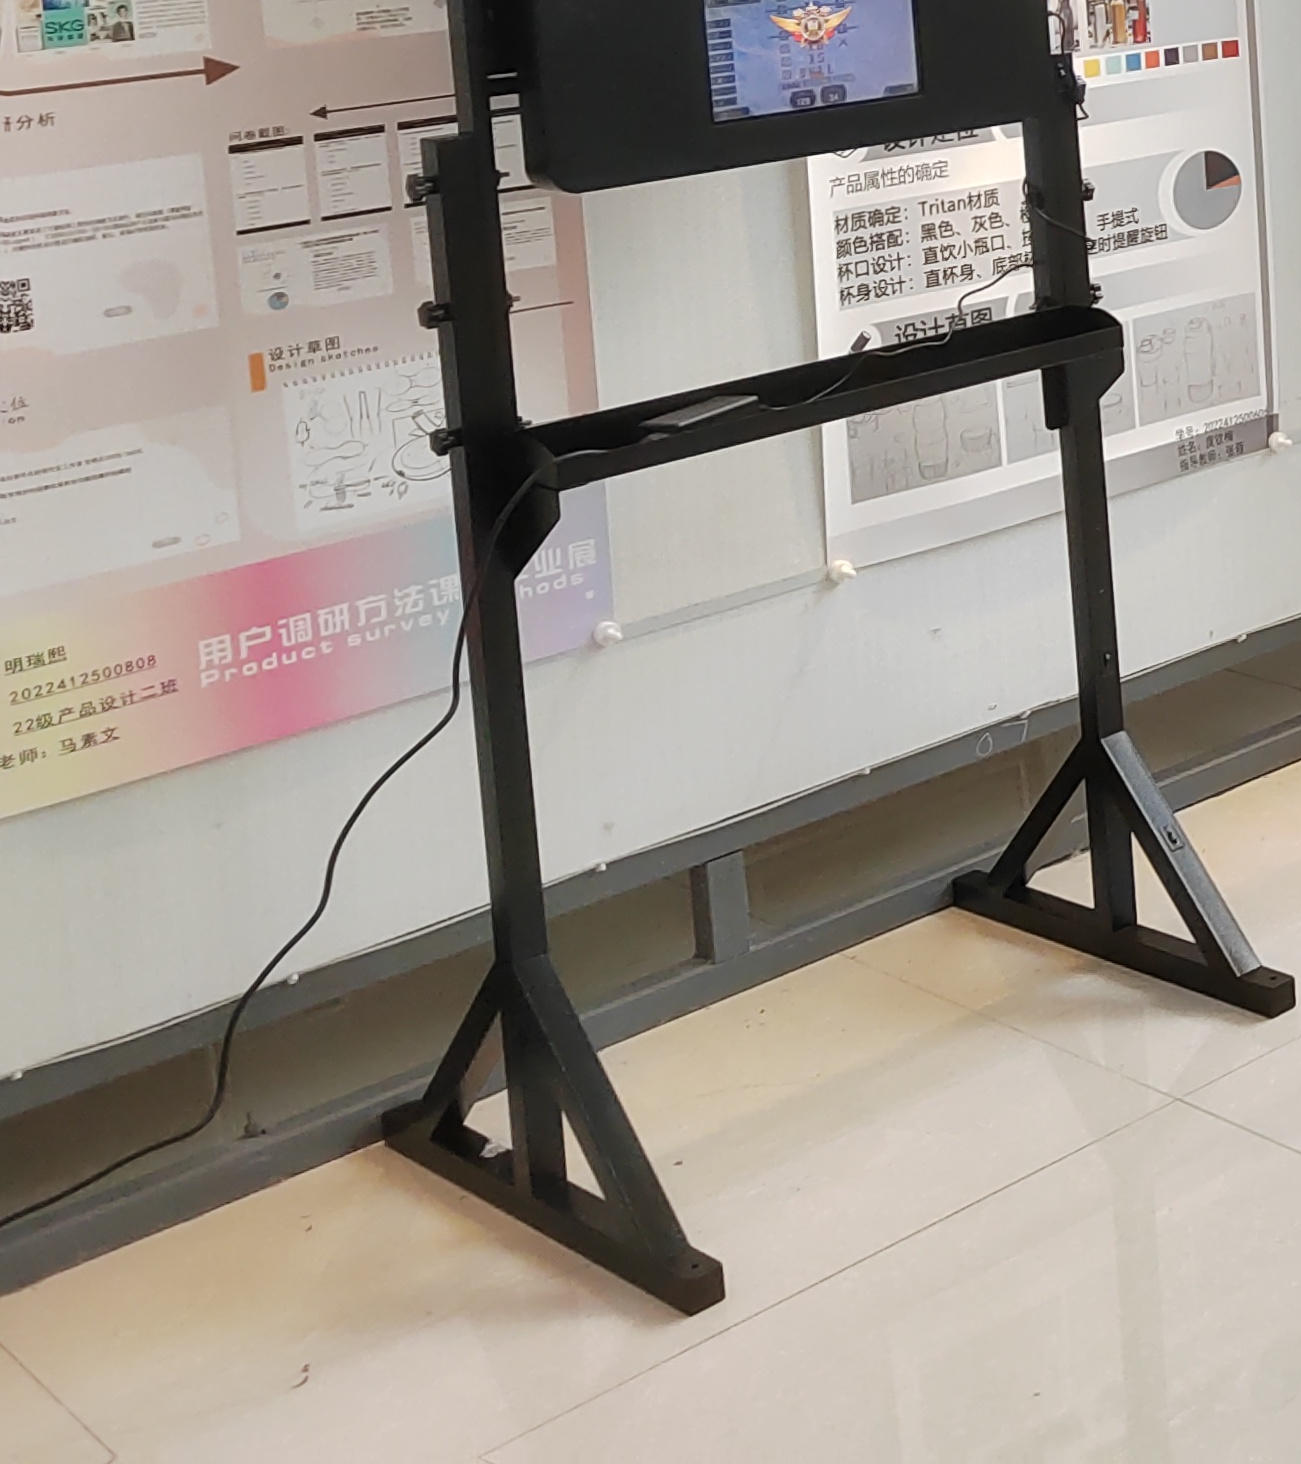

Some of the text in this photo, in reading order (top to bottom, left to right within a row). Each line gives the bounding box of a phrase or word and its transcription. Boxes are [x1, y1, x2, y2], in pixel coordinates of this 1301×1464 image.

[44, 18, 85, 35] SKG
[828, 159, 950, 198] 产品属性的确定
[1096, 206, 1140, 232] 手提式
[267, 335, 342, 362] 设计草图
[200, 639, 335, 688] Product
[345, 606, 452, 648] survey
